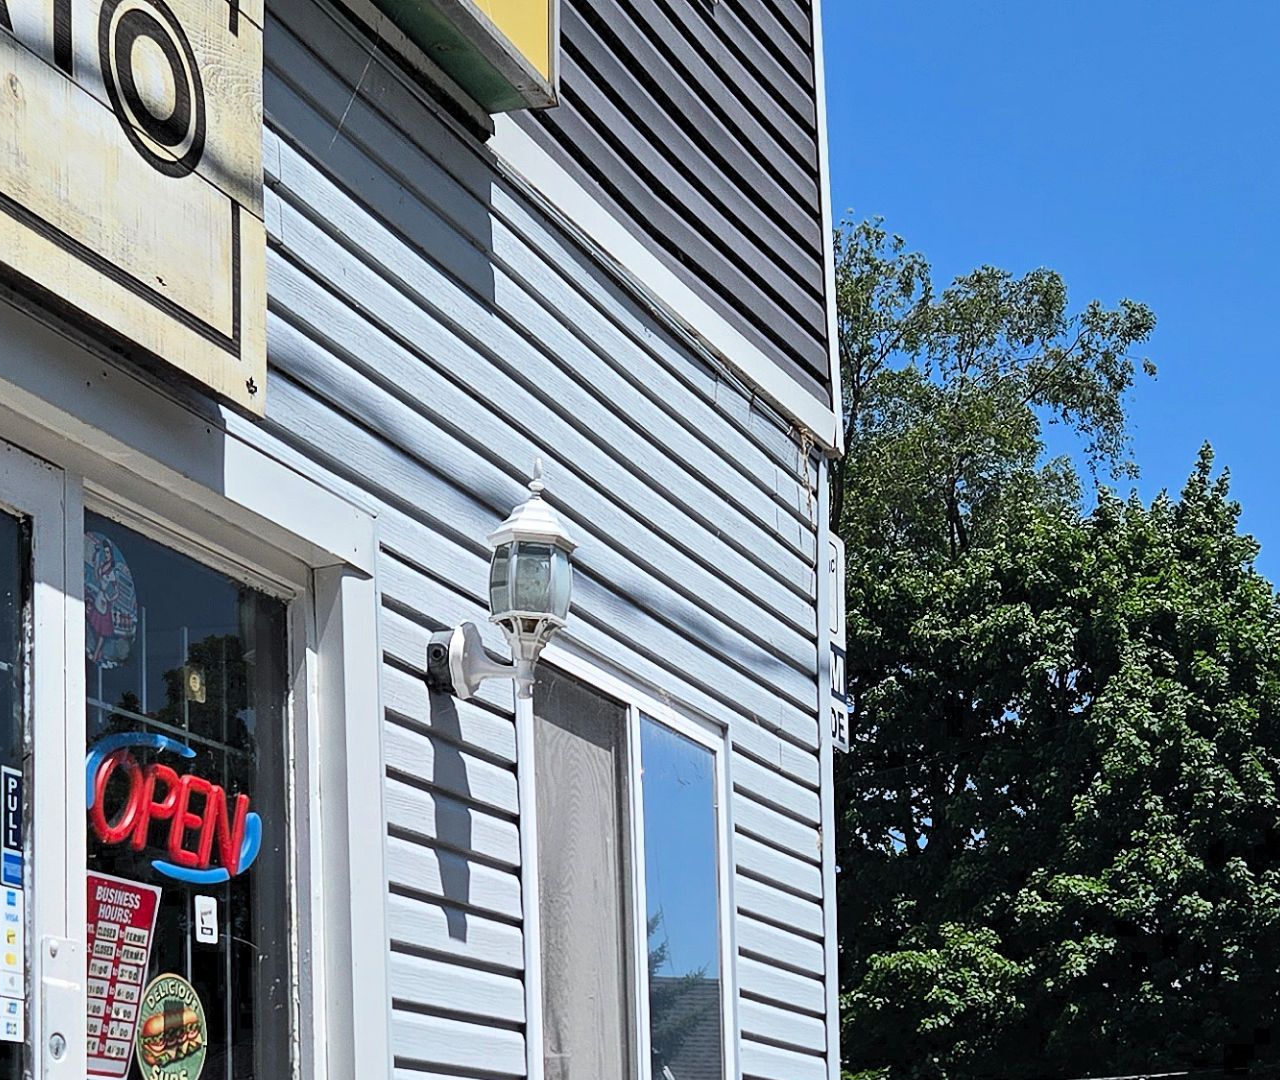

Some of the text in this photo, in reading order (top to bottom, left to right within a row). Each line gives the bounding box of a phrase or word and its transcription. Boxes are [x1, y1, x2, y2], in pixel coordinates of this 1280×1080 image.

[8, 777, 18, 847] PULL
[91, 748, 250, 877] OPEN
[96, 885, 141, 909] BUSINESS
[5, 912, 19, 922] VISA
[98, 903, 132, 924] HOURS:
[147, 981, 198, 1010] DELICIOUS
